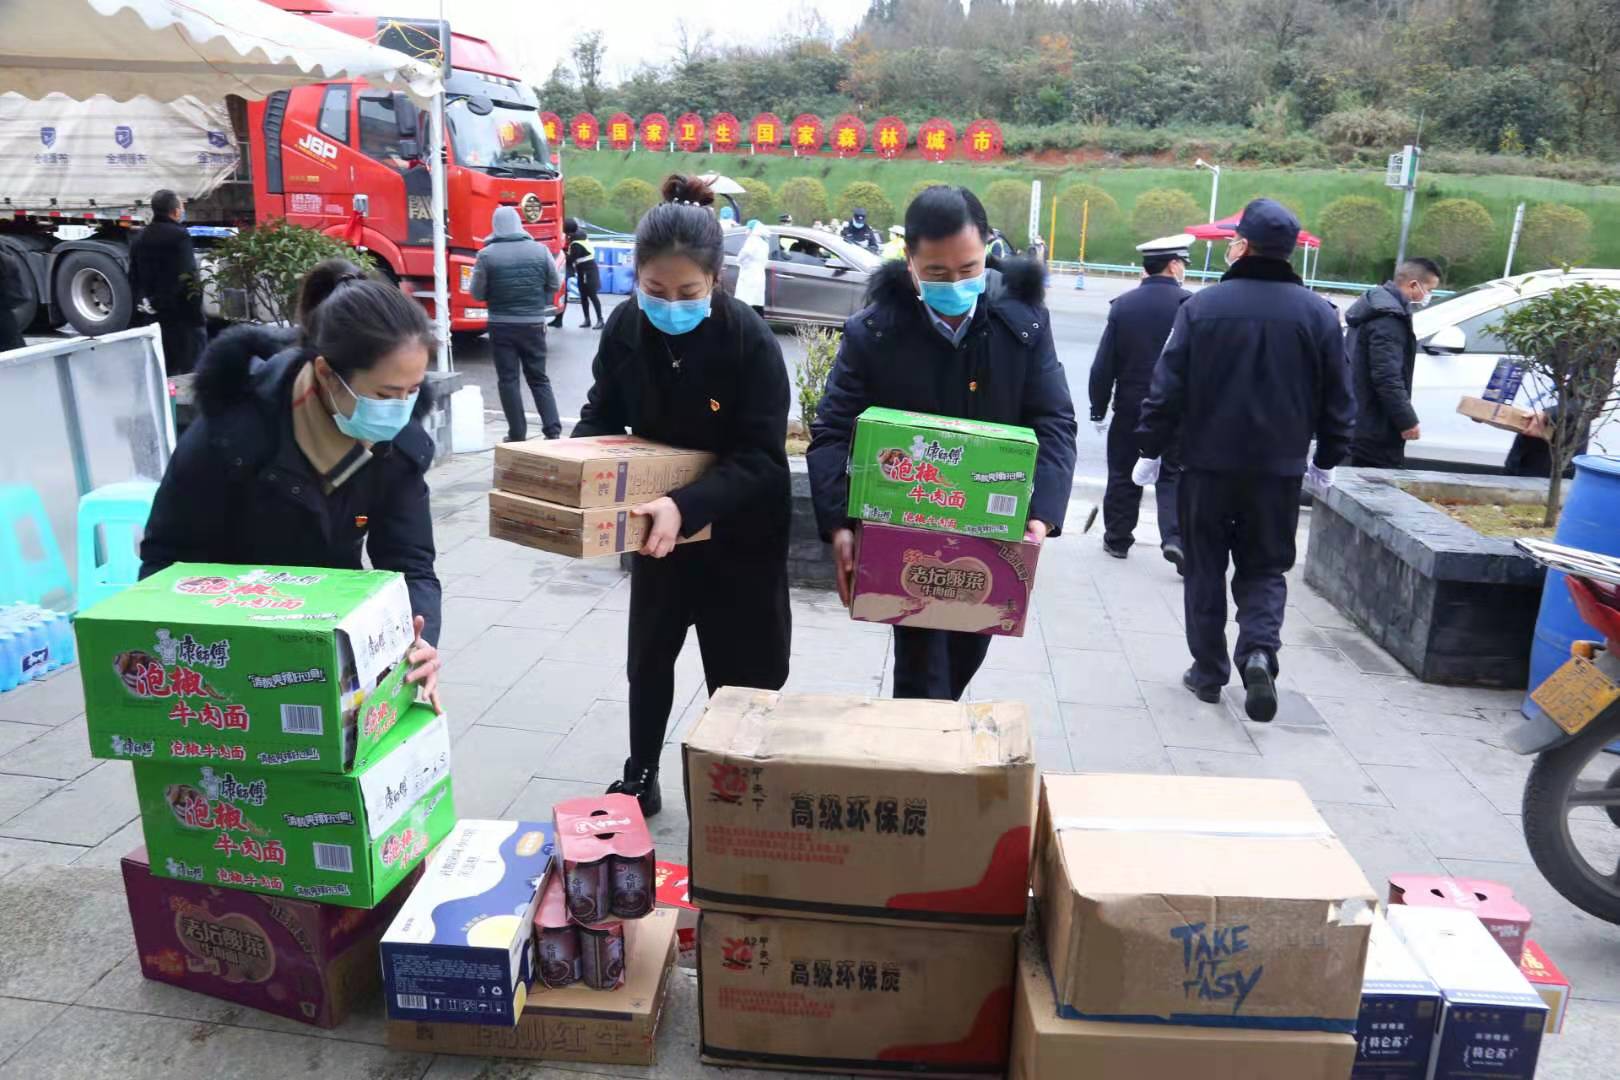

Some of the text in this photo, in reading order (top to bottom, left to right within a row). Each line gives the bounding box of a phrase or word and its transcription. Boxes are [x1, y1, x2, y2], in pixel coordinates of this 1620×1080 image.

[890, 457, 941, 482] 泡椒
[907, 485, 967, 509] 牛肉面
[903, 511, 958, 529] 泡椒牛肉面
[909, 565, 986, 591] 老坛酸菜
[136, 663, 209, 698] 泡椒
[168, 700, 250, 732] 牛肉面
[170, 740, 247, 762] 泡椒牛肉面
[185, 798, 251, 832] 泡椒
[790, 792, 929, 837] 高级环保炭
[214, 833, 286, 865] 牛肉面
[217, 868, 285, 892] 泡椒牛肉面
[1170, 921, 1250, 975] TAKE
[790, 959, 901, 993] 高级环保炭
[1197, 958, 1228, 981] IT
[1369, 1035, 1403, 1049] 特仑苏
[1472, 1046, 1508, 1060] 特仑苏
